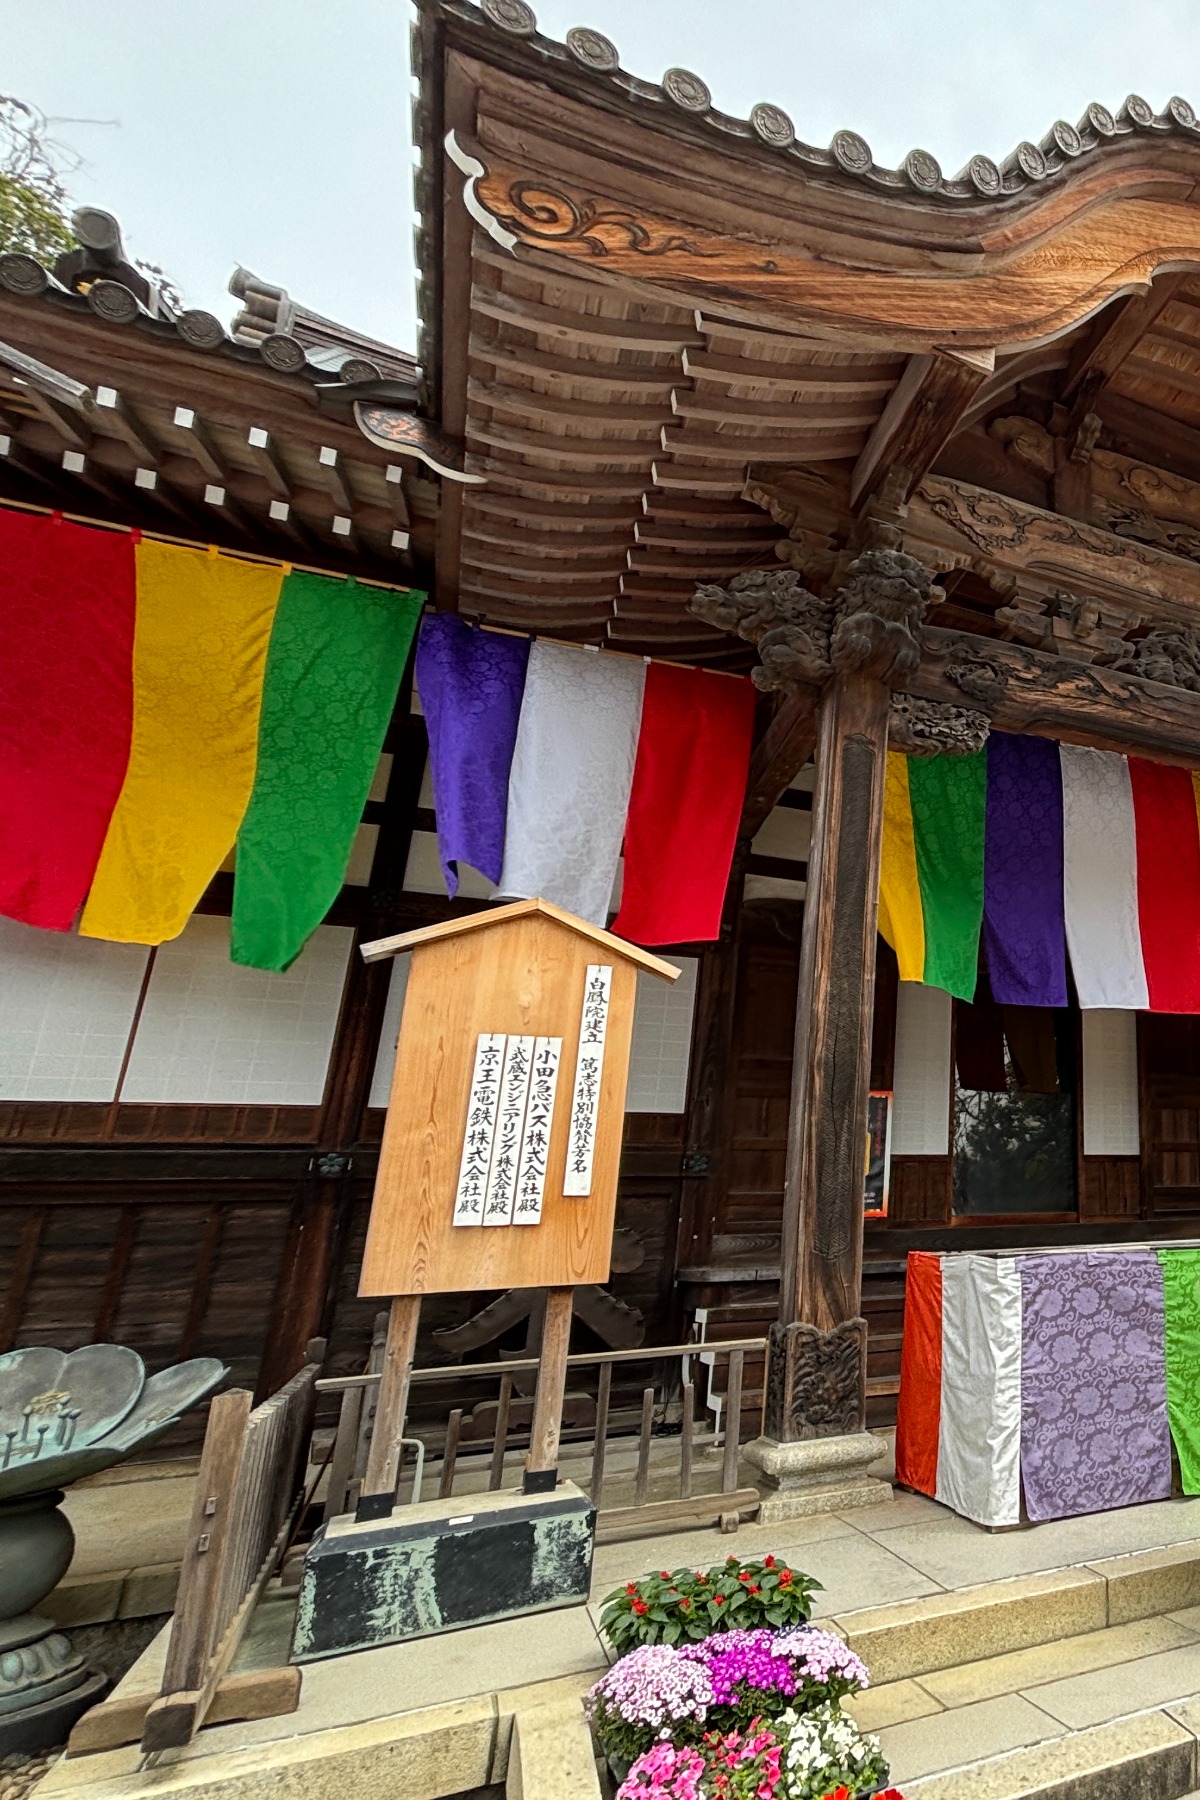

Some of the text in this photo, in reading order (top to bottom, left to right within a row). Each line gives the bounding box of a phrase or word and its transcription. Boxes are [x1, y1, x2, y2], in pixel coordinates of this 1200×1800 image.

[582, 977, 608, 1044] 白鳳院建立
[457, 1046, 501, 1214] 京王電鉄株式会社殿
[486, 1047, 530, 1215] 武蔵エンジニアリング株式会社殿
[517, 1050, 558, 1213] 小田急バス株式会社殿
